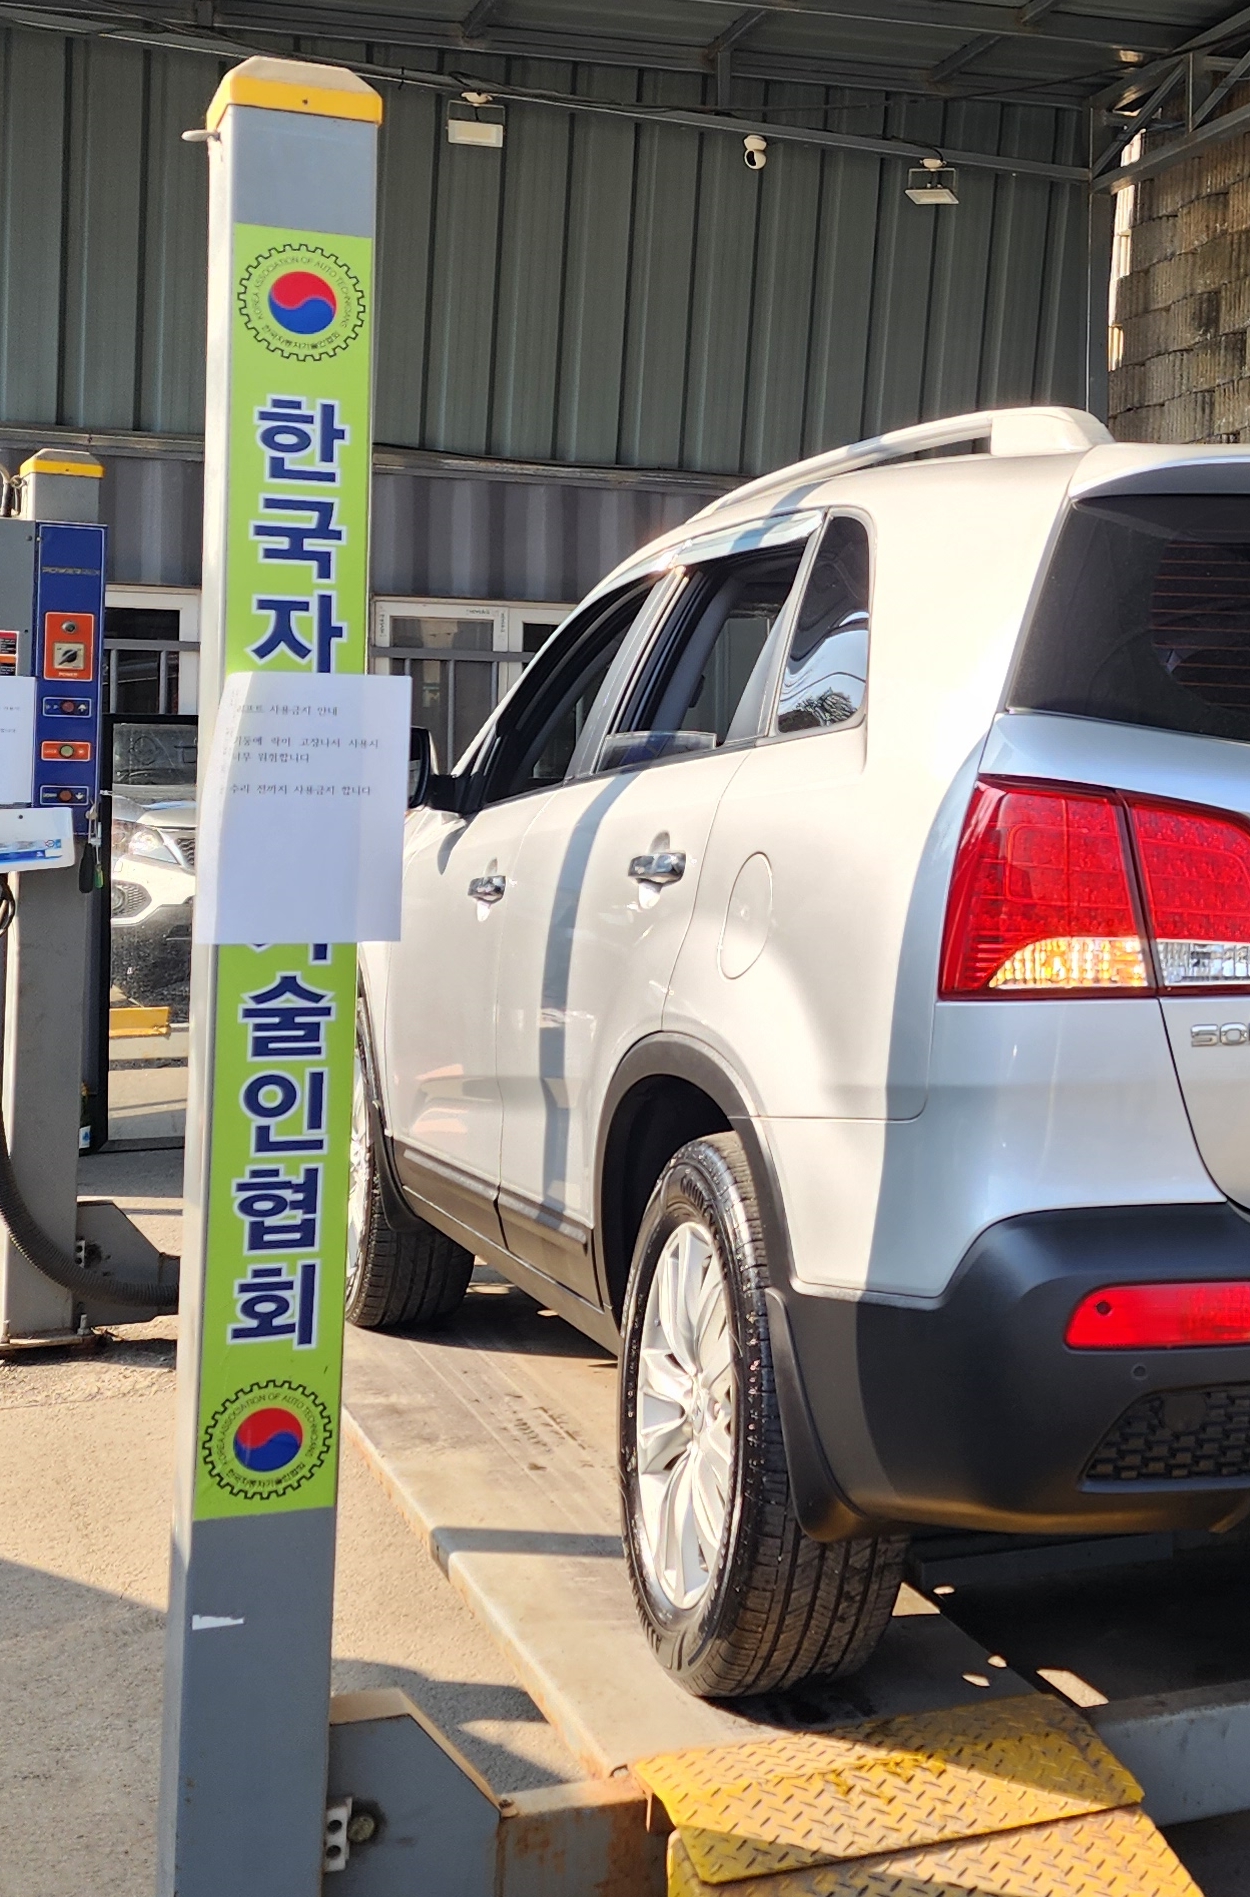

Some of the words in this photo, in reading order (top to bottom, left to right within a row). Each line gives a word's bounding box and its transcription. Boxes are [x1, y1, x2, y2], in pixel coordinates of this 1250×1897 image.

[269, 704, 311, 716] 사용금지
[317, 705, 338, 717] 안내
[293, 784, 335, 796] 사용금지
[341, 785, 371, 796] 합니다
